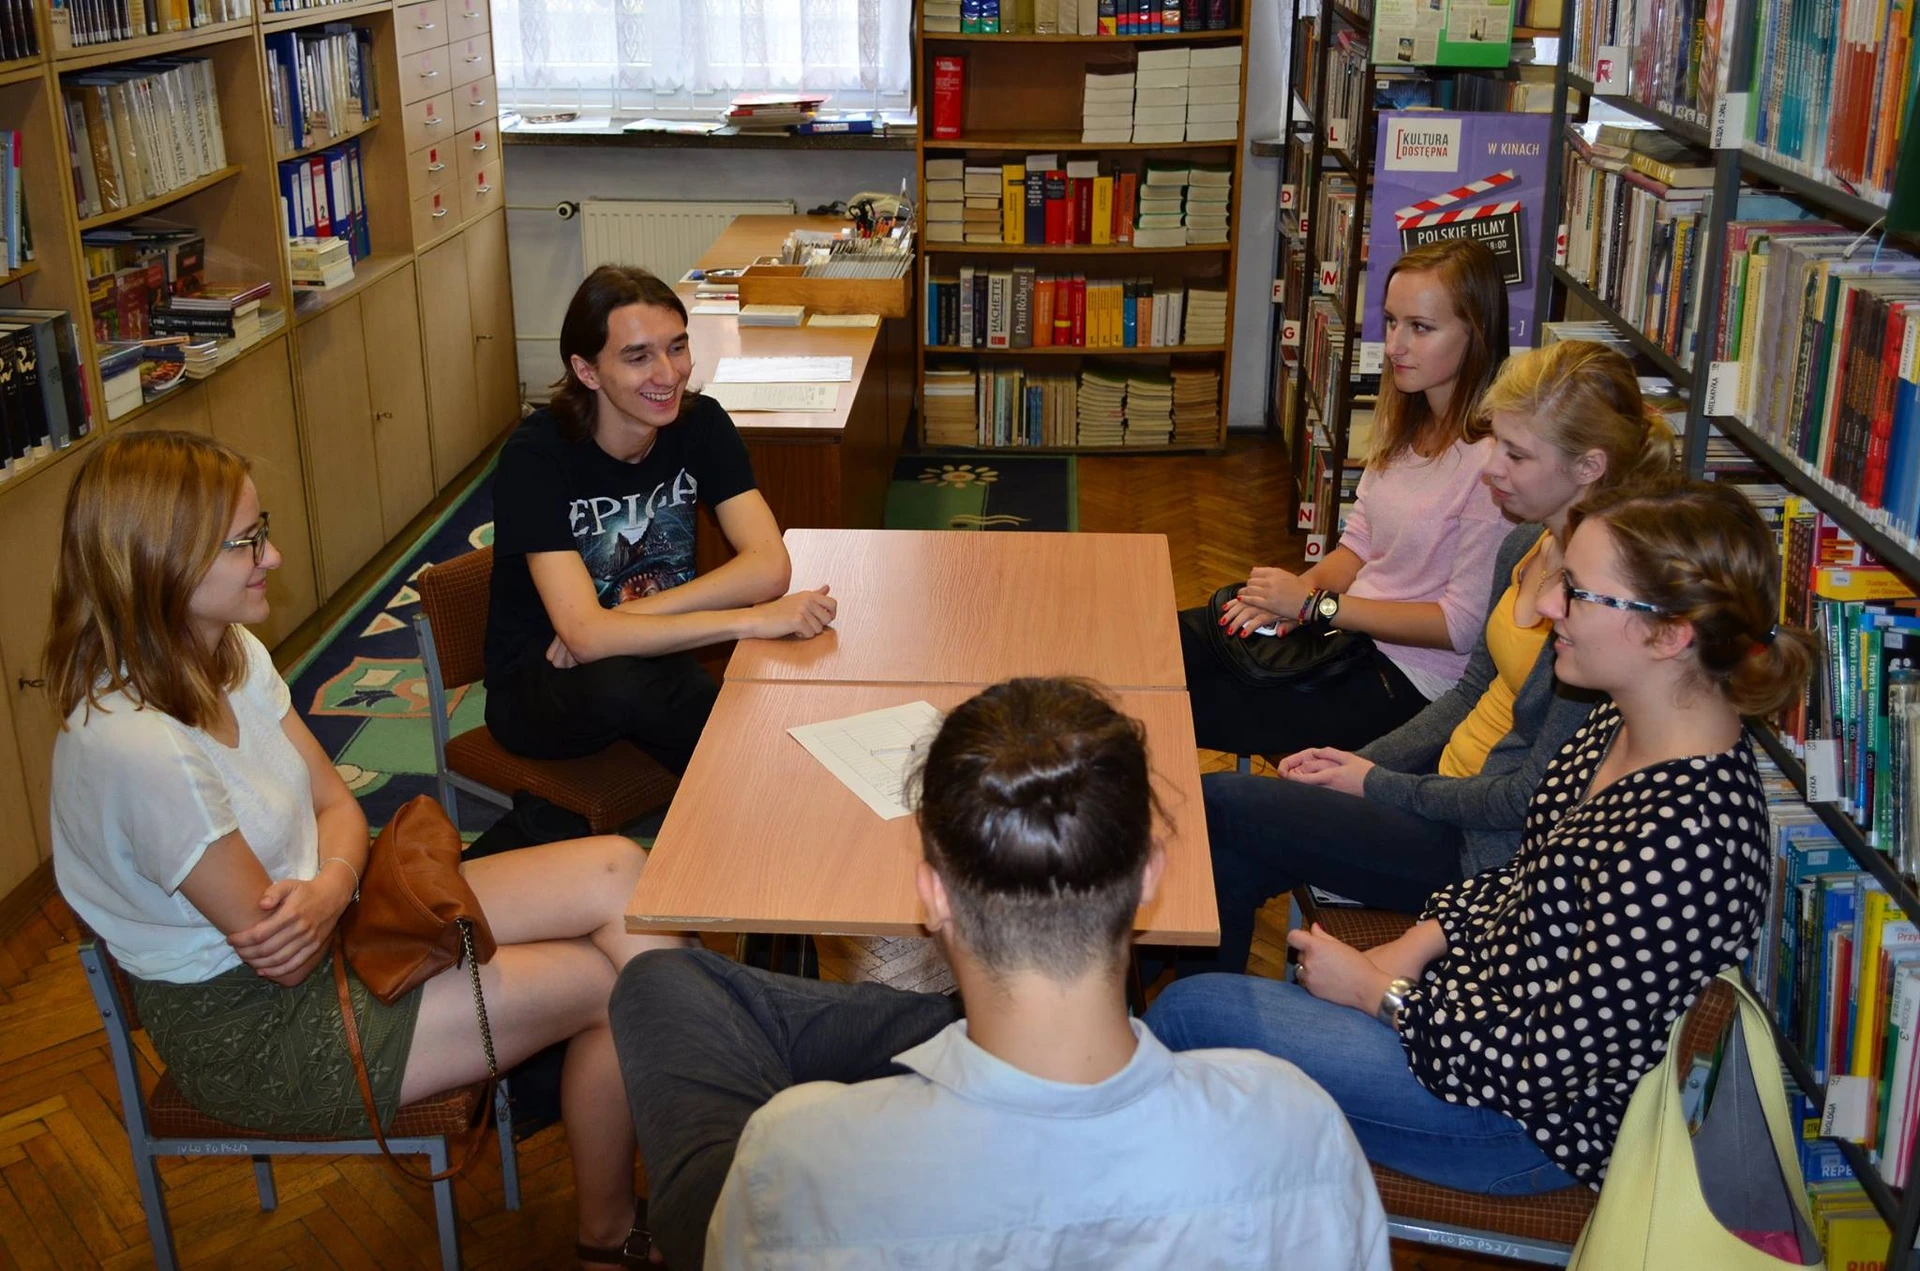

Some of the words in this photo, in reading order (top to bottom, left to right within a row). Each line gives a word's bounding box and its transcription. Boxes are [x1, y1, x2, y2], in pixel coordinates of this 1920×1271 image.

[1596, 60, 1613, 83] R
[1329, 126, 1338, 142] L
[1403, 133, 1449, 146] KULTURA
[1402, 146, 1448, 158] DOSTĘPNA
[1487, 142, 1499, 155] W
[1501, 142, 1540, 156] KINACH
[1281, 190, 1292, 203] D
[319, 206, 326, 219] 2
[1471, 219, 1506, 238] FILMY
[1323, 269, 1337, 285] M
[1273, 284, 1281, 297] F
[991, 278, 1001, 333] HACHETTE
[1283, 326, 1295, 339] G
[569, 467, 698, 537] EPICA
[1300, 509, 1312, 522] N
[1306, 543, 1320, 556] O
[1831, 624, 1840, 653] fizyka
[1849, 628, 1857, 657] fizyka
[1867, 654, 1877, 685] fizyka
[1832, 661, 1842, 715] astronomia
[1849, 665, 1858, 719] astronomia
[1867, 692, 1877, 748] astronomia
[1809, 775, 1817, 801] FIZYKA
